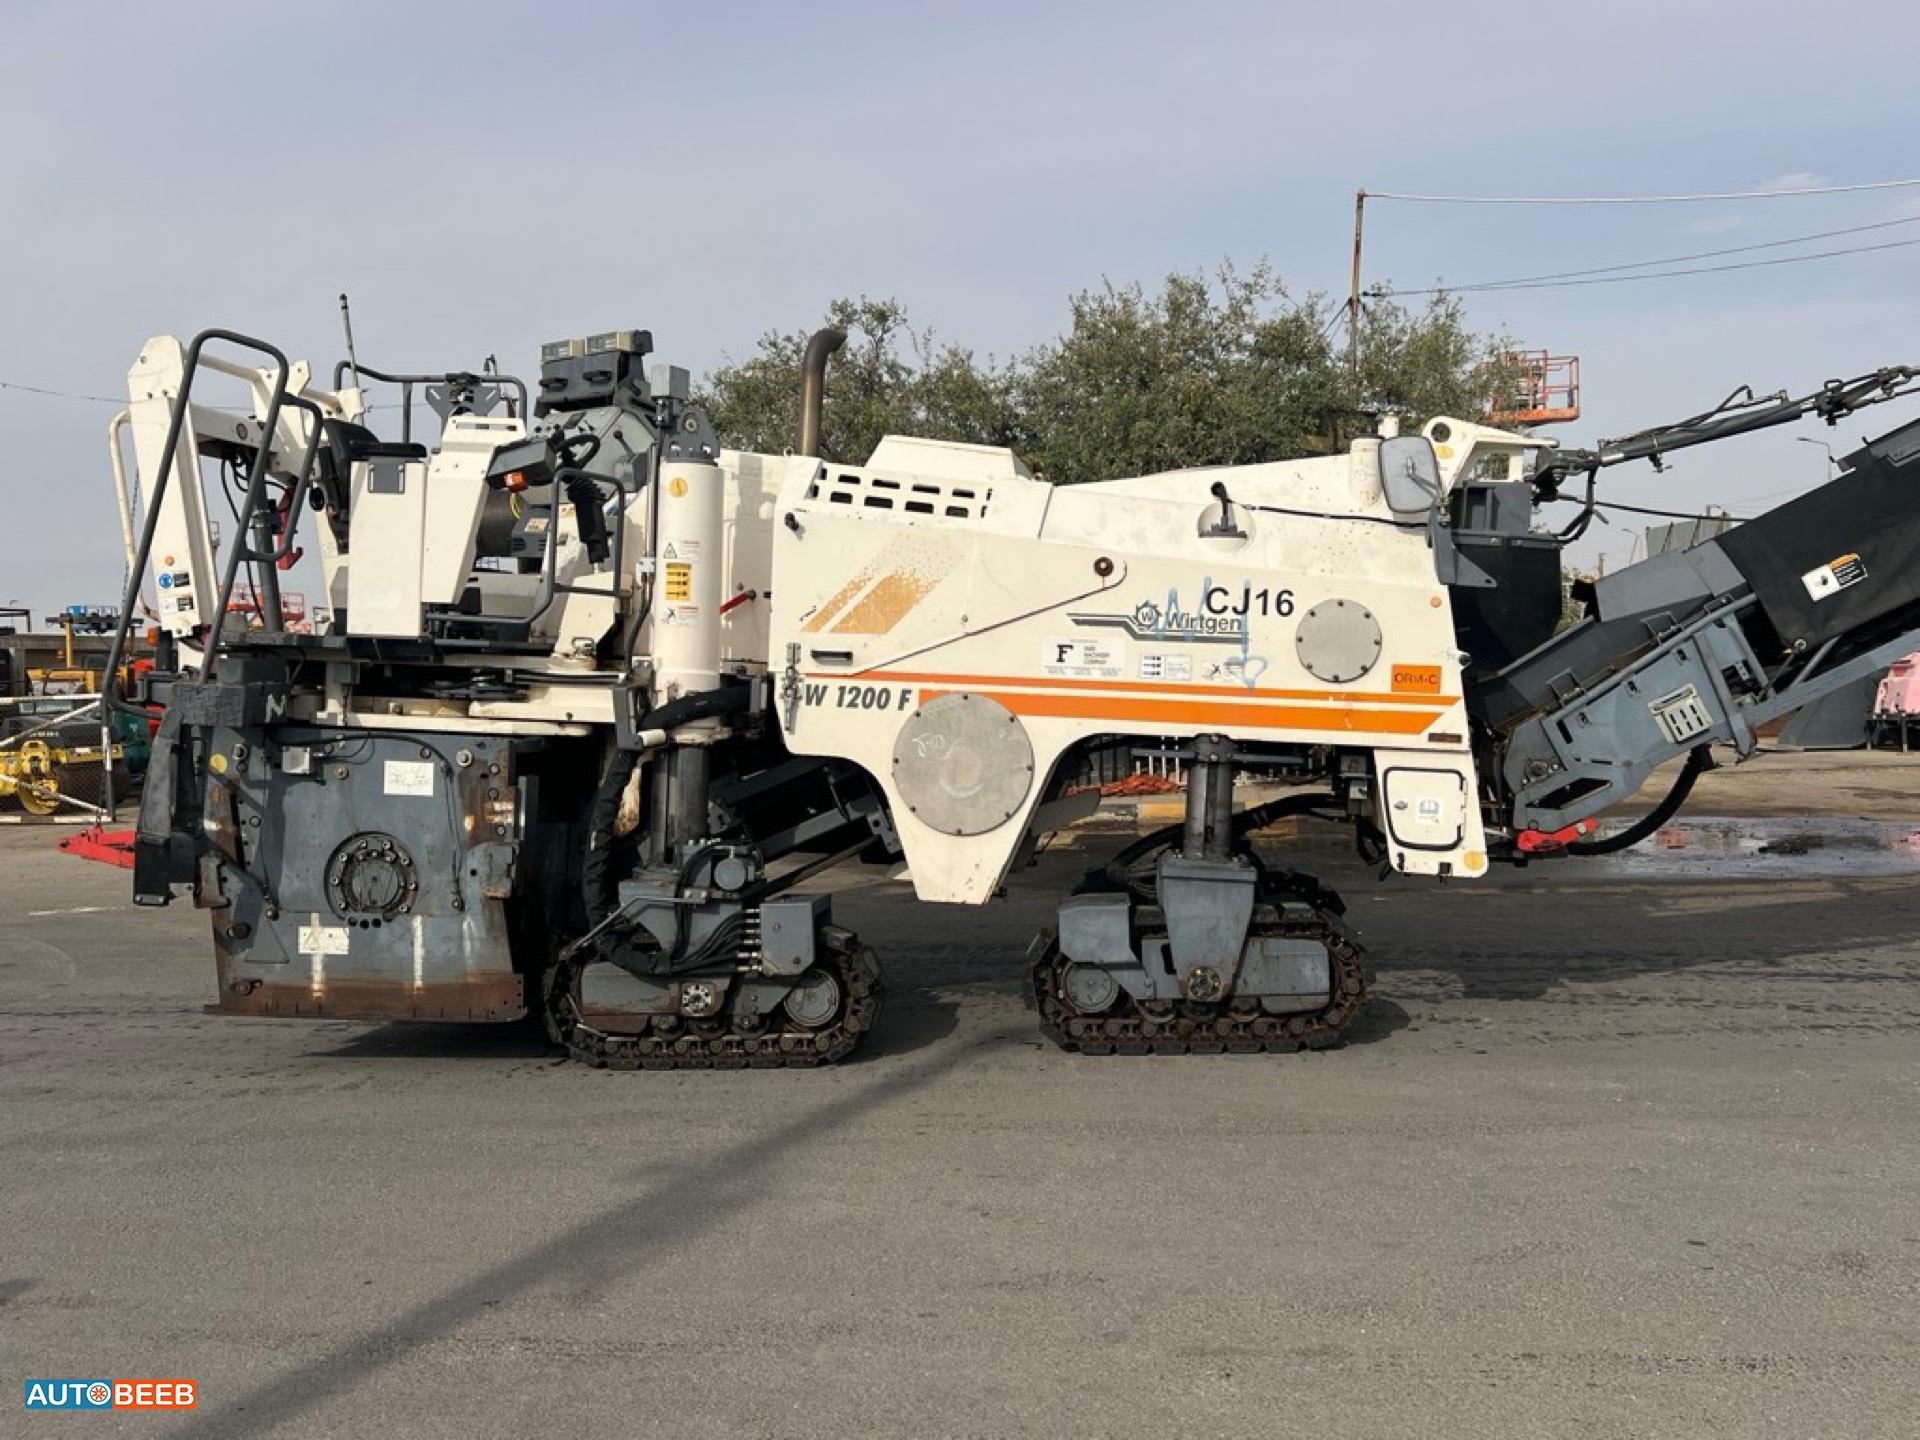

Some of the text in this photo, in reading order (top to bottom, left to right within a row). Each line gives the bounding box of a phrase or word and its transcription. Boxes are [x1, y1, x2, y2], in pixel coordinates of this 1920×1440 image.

[1205, 587, 1294, 617] CJ16
[1164, 612, 1242, 634] Wirtgen
[1056, 645, 1073, 662] F
[805, 684, 912, 711] W 1200 F
